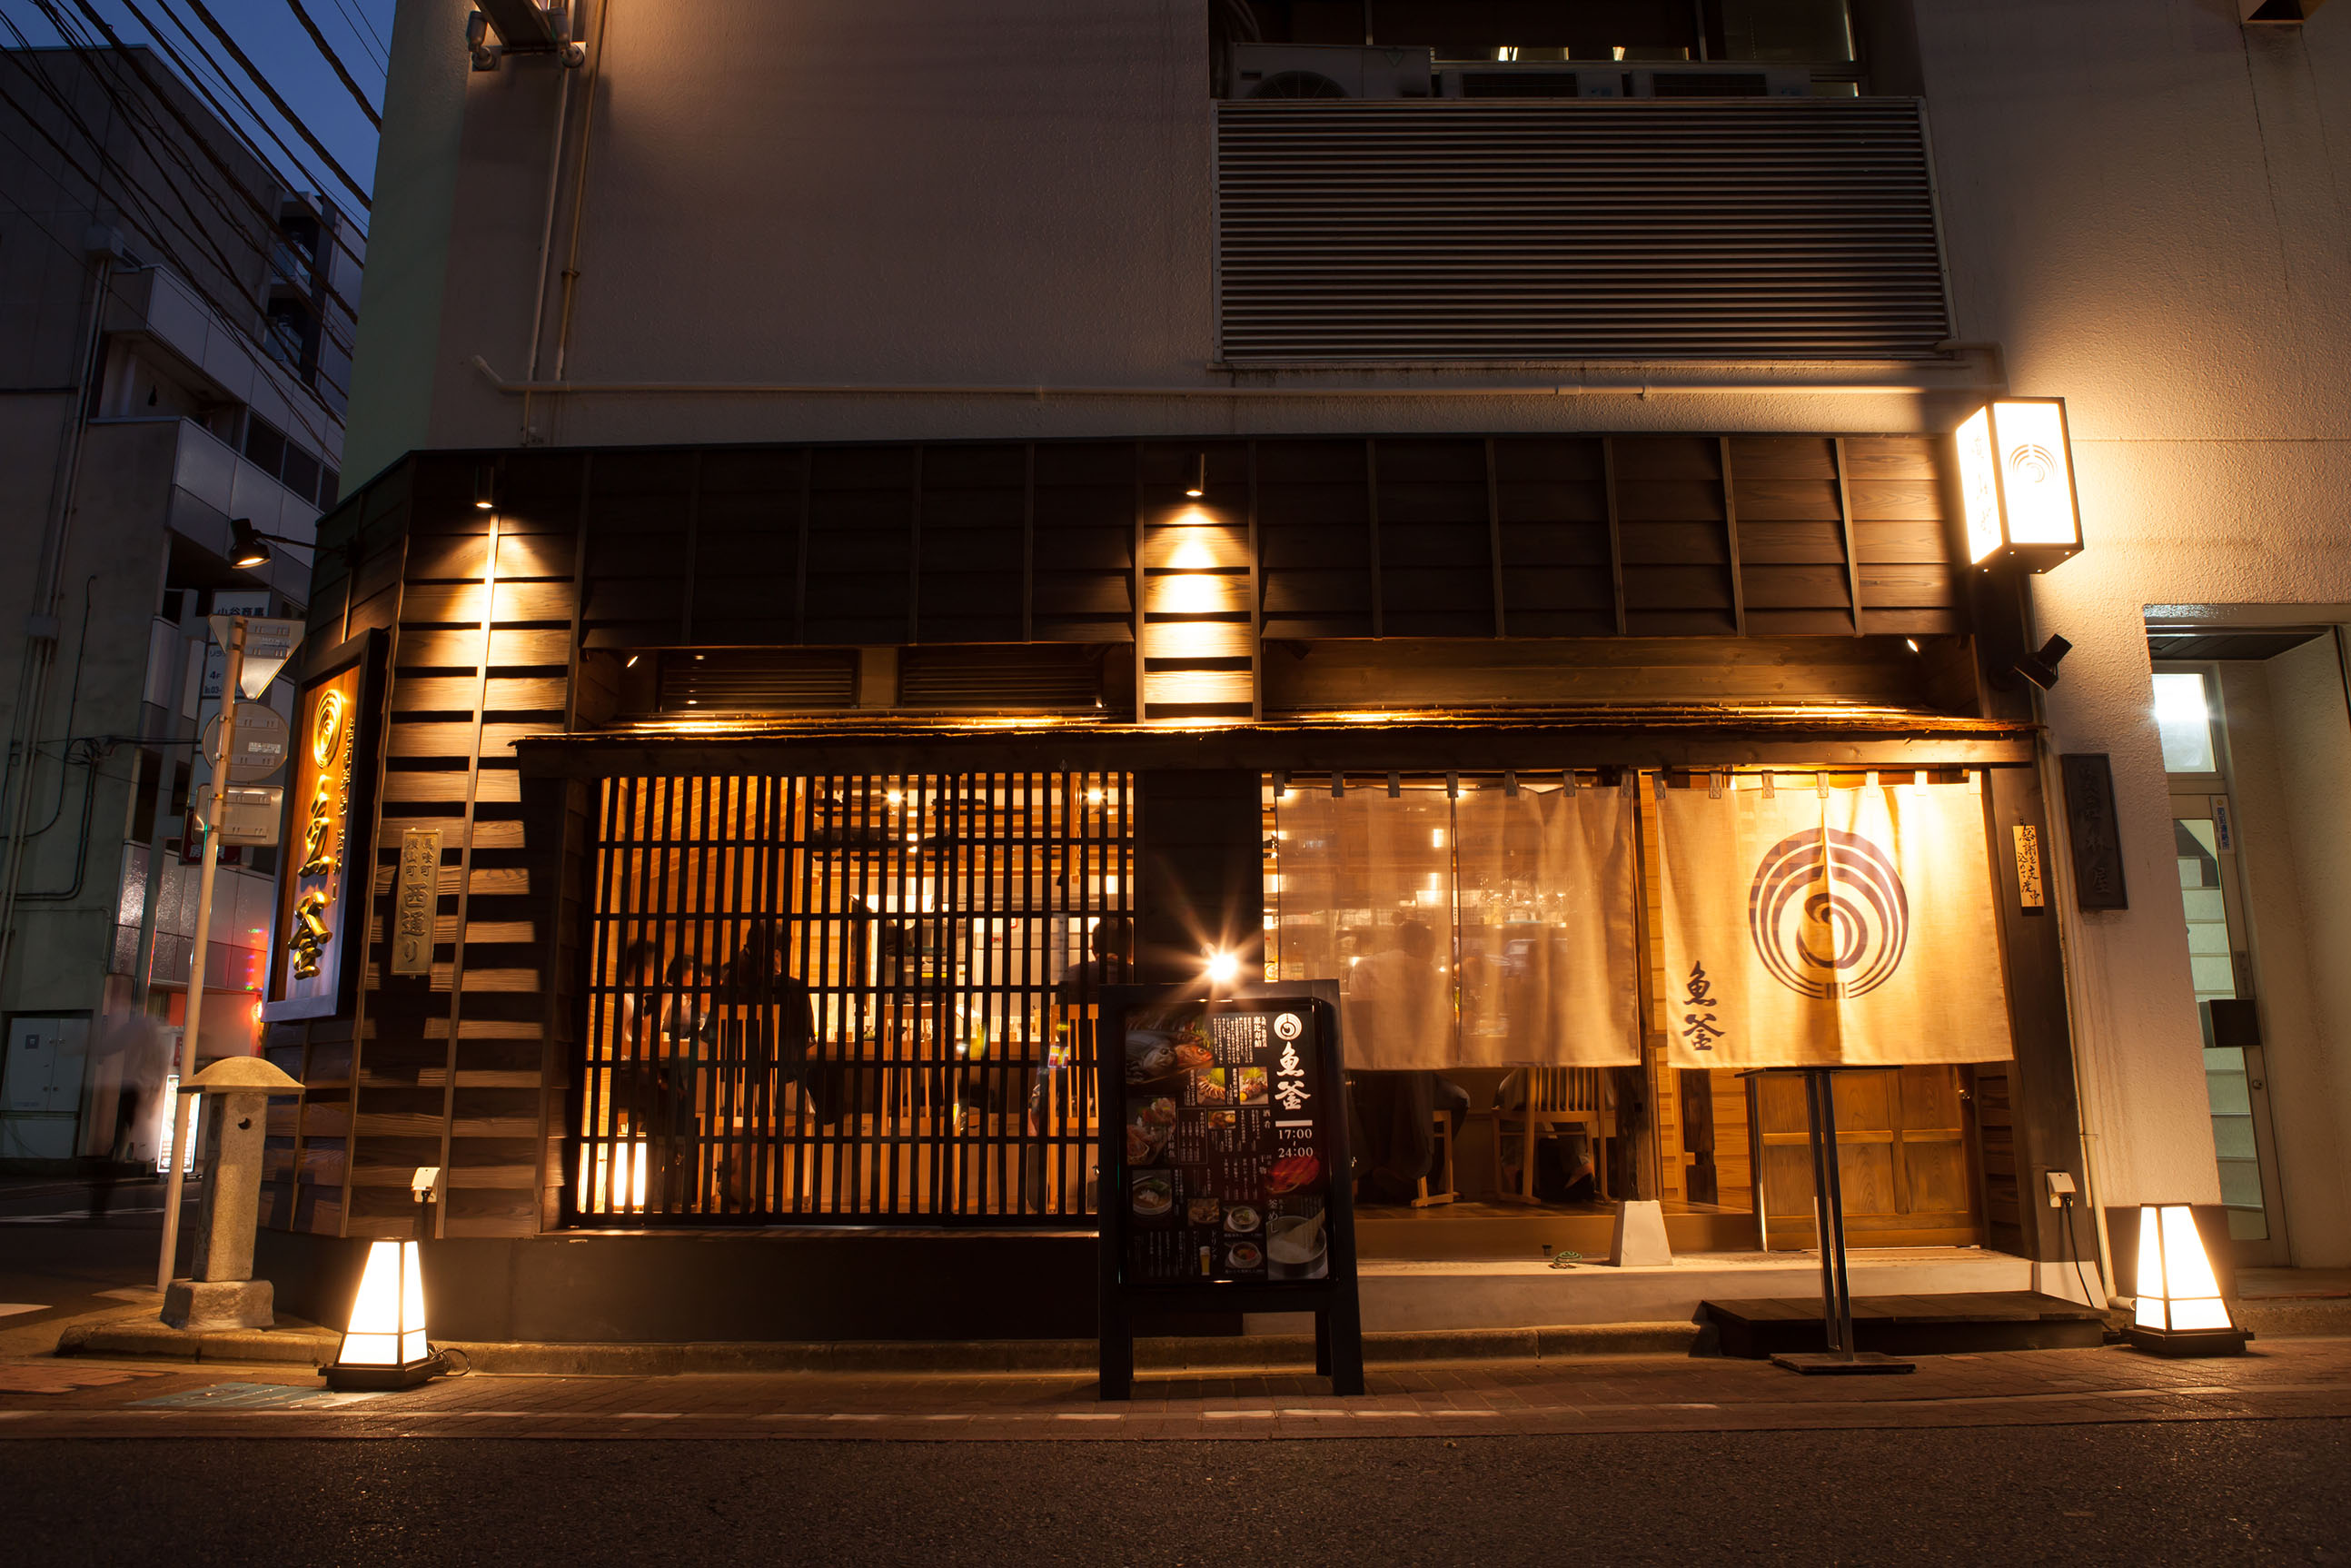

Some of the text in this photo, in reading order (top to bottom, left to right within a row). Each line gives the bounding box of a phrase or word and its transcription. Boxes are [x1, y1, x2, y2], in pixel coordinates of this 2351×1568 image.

[402, 880, 430, 963] 西通り
[1682, 959, 1726, 1052] 魚釜
[1275, 1040, 1311, 1110] 魚釜
[1278, 1128, 1313, 1140] 17:00
[1278, 1146, 1314, 1158] 24:00
